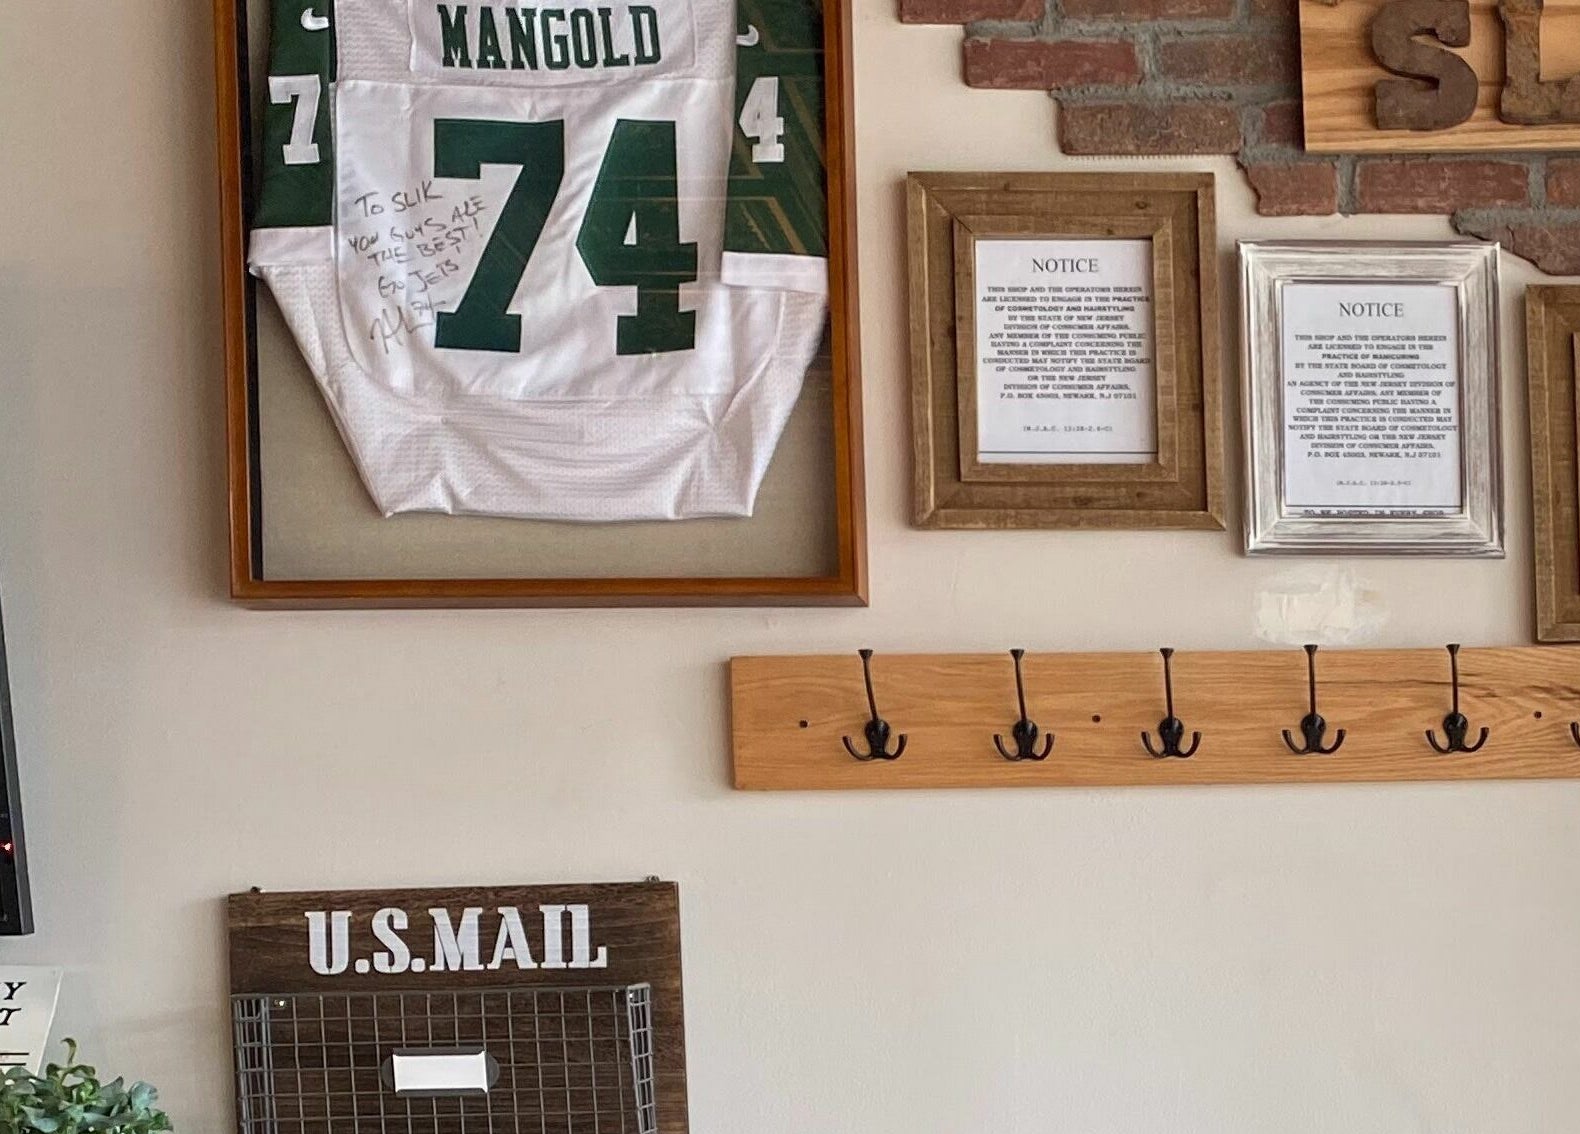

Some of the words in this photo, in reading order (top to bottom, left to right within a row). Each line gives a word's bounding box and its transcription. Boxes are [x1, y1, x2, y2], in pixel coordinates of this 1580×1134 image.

[436, 3, 662, 71] MANGOLD
[267, 73, 322, 165] 7
[737, 76, 786, 164] 4
[391, 180, 444, 213] SLIK
[432, 117, 700, 357] 74
[1032, 258, 1100, 273] NOTICE
[1339, 302, 1405, 318] NOTICE
